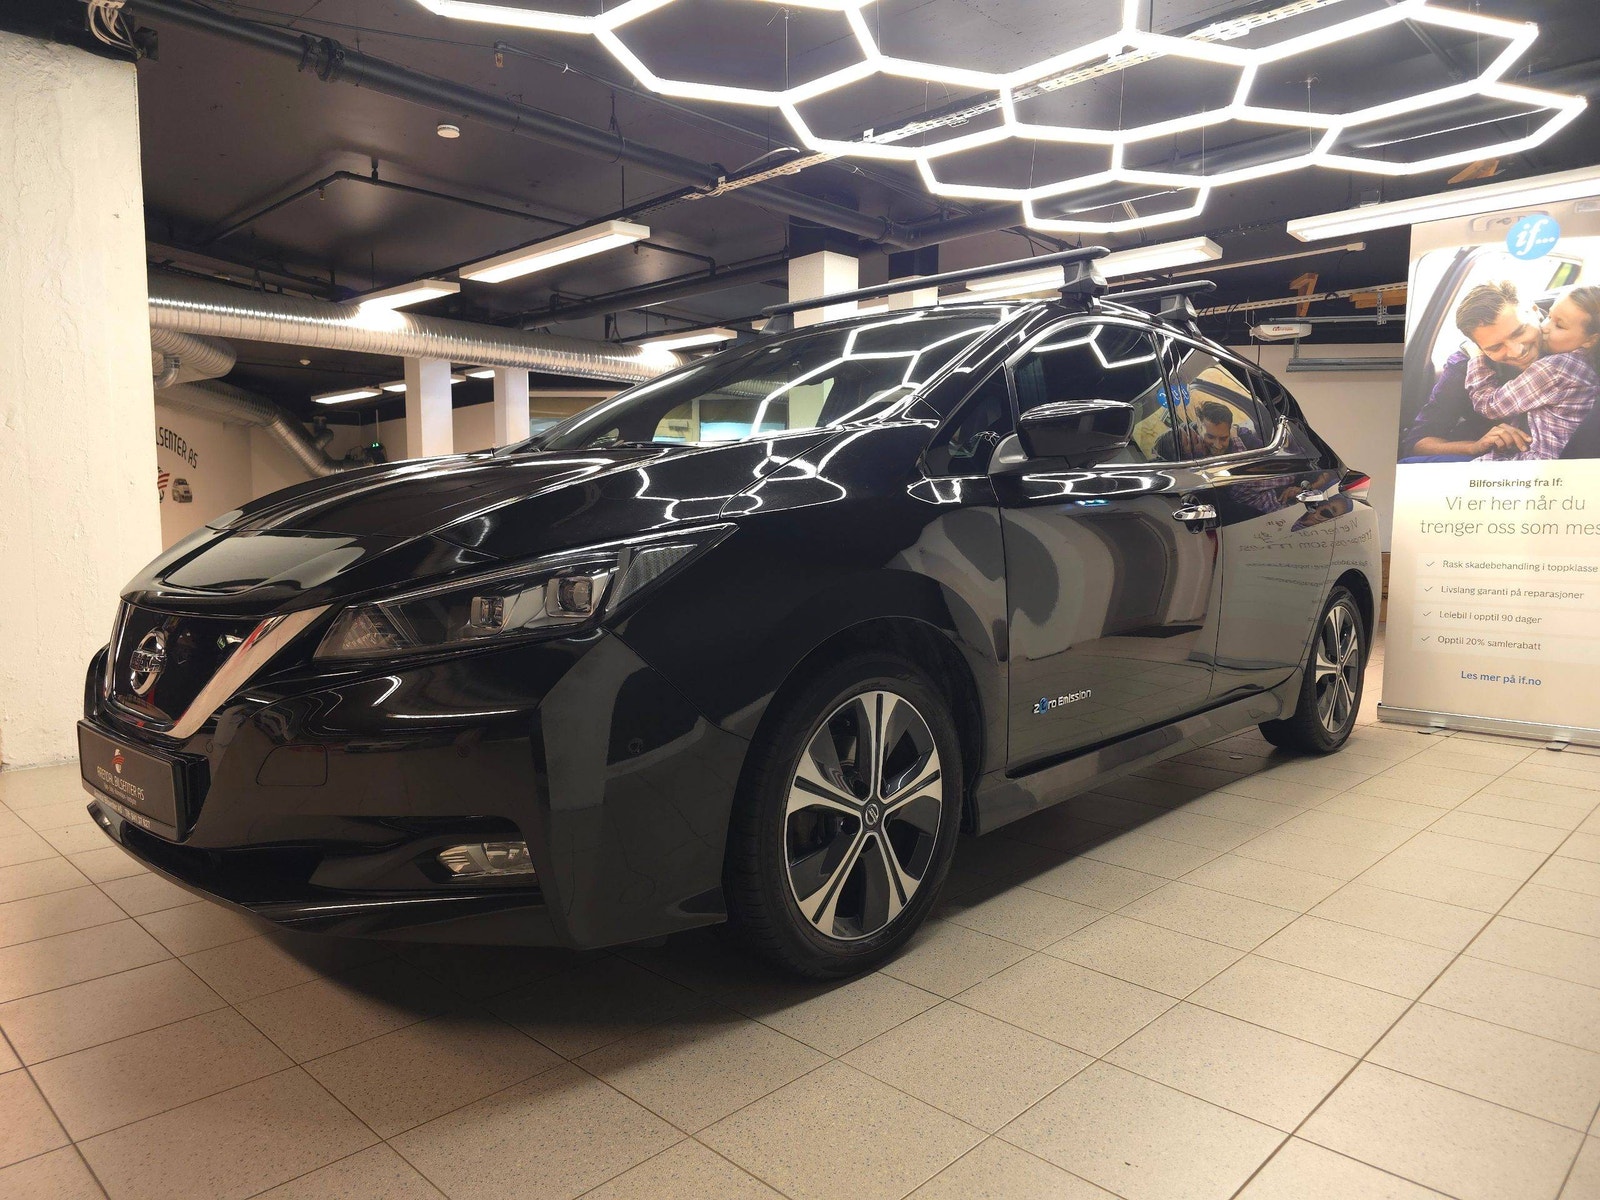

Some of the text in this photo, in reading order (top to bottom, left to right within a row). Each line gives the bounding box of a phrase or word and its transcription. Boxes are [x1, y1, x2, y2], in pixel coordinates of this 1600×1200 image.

[187, 448, 199, 469] AS
[1469, 478, 1563, 488] Bilforsikring fra If:
[1446, 495, 1586, 511] Vi er her når du
[1420, 519, 1483, 537] trenger
[1487, 523, 1516, 534] oss
[1520, 523, 1559, 535] som
[1442, 560, 1463, 568] Rask
[1464, 561, 1540, 572] skadebehandling
[1547, 564, 1599, 573] toppklasse
[1441, 585, 1584, 600] Livslang garanti på reparasjoner
[1439, 610, 1467, 619] Leiebil
[1474, 613, 1499, 622] opptil
[1501, 614, 1513, 622] 90
[1515, 615, 1542, 625] dager
[1437, 635, 1541, 651] Opptil 20% samlerabatt
[1461, 670, 1542, 686] Les mer på if.no
[1058, 689, 1092, 706] Emission
